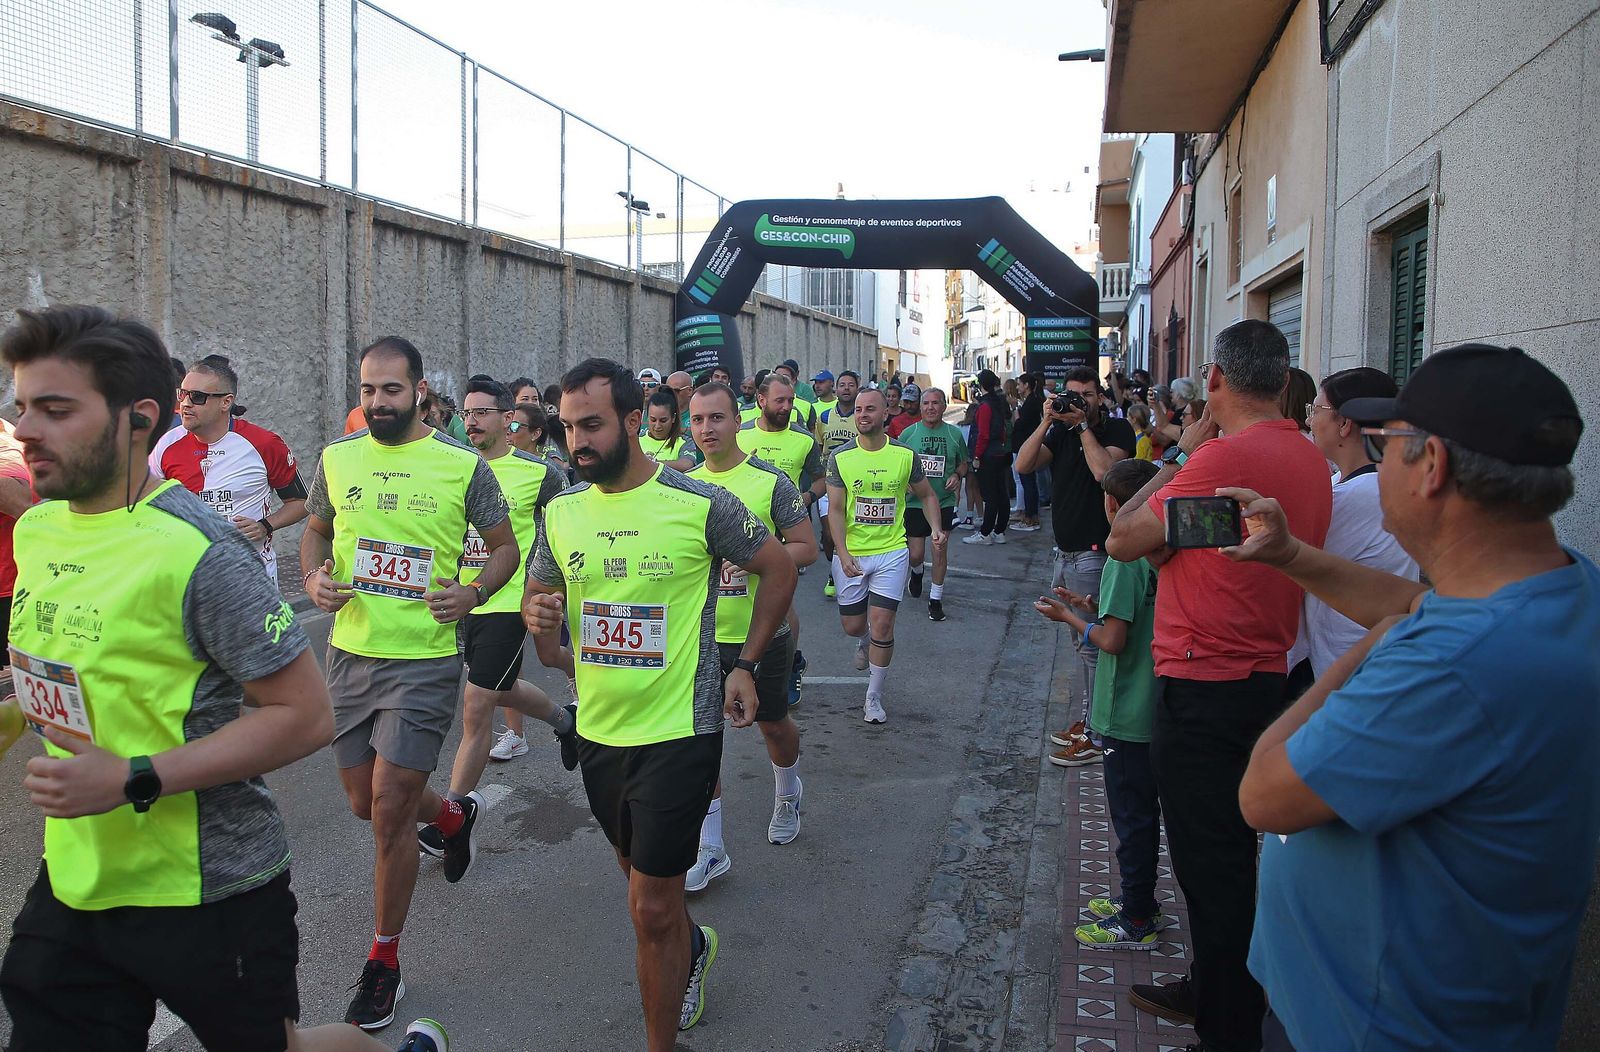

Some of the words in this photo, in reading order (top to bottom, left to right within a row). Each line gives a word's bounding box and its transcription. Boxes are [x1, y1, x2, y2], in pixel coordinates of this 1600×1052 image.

[772, 214, 804, 223] Gestión
[805, 217, 811, 225] y
[812, 217, 866, 226] cronometraje
[867, 218, 879, 226] de
[880, 219, 914, 227] eventos
[915, 218, 962, 228] deportivos
[760, 230, 851, 244] GES&CON-CHIP
[706, 226, 734, 269] PROFESIONALIDAD
[710, 246, 729, 272] FIABILIDAD
[715, 251, 732, 275] SERIEDAD
[720, 247, 742, 278] COMPROMISO
[1014, 260, 1056, 297] PROFESIONALIDAD
[1002, 274, 1032, 302] COMPROMISO
[1033, 318, 1086, 326] CRONOMETRAJE
[922, 460, 938, 471] 302
[384, 493, 399, 501] PEOR
[863, 505, 886, 517] 381
[384, 543, 405, 555] CROSS
[652, 551, 659, 560] LA
[368, 554, 412, 583] 343
[611, 557, 627, 566] PEOR
[36, 600, 43, 612] EL
[42, 602, 59, 614] PEOR
[609, 605, 632, 617] CROSS
[596, 619, 643, 650] 345
[25, 676, 69, 725] 334
